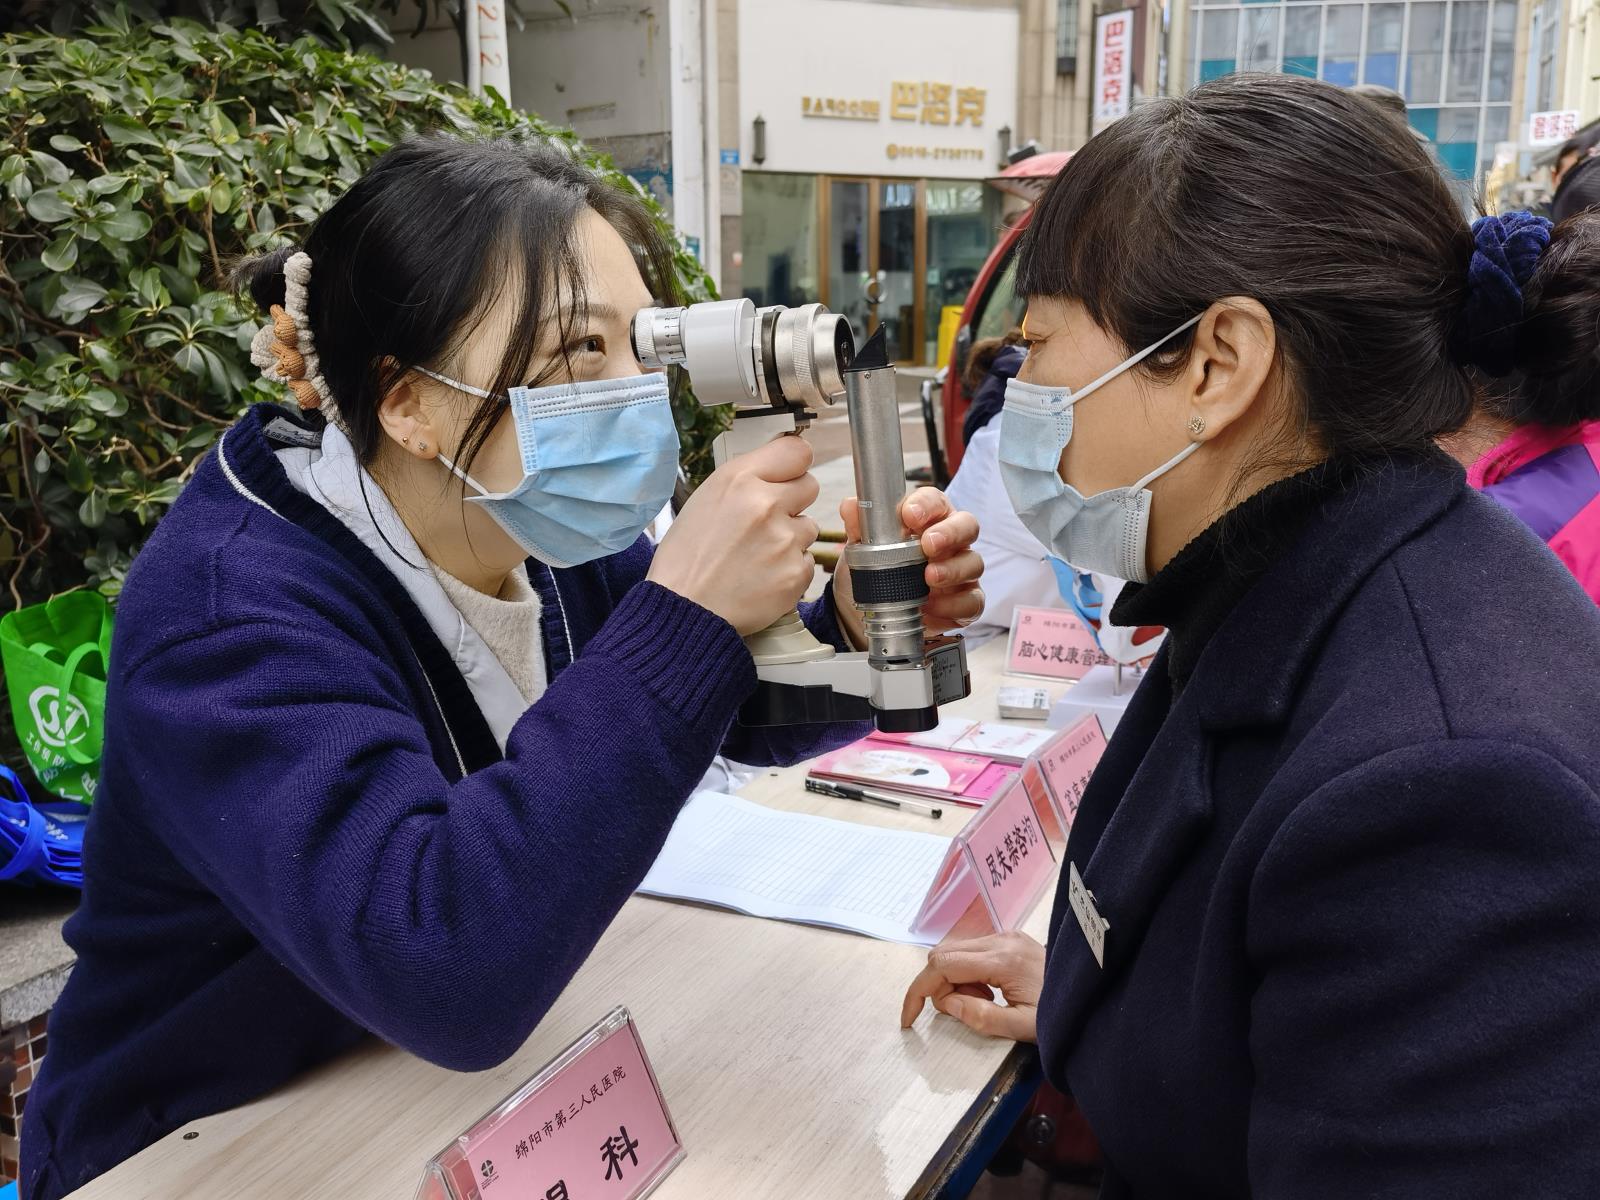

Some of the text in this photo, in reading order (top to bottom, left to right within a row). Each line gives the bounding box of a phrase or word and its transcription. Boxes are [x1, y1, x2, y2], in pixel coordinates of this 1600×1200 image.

[889, 80, 987, 127] 巴洛克
[985, 815, 1038, 888] 尿失禁咨询
[514, 1065, 627, 1160] 绵阳市第三人民医院
